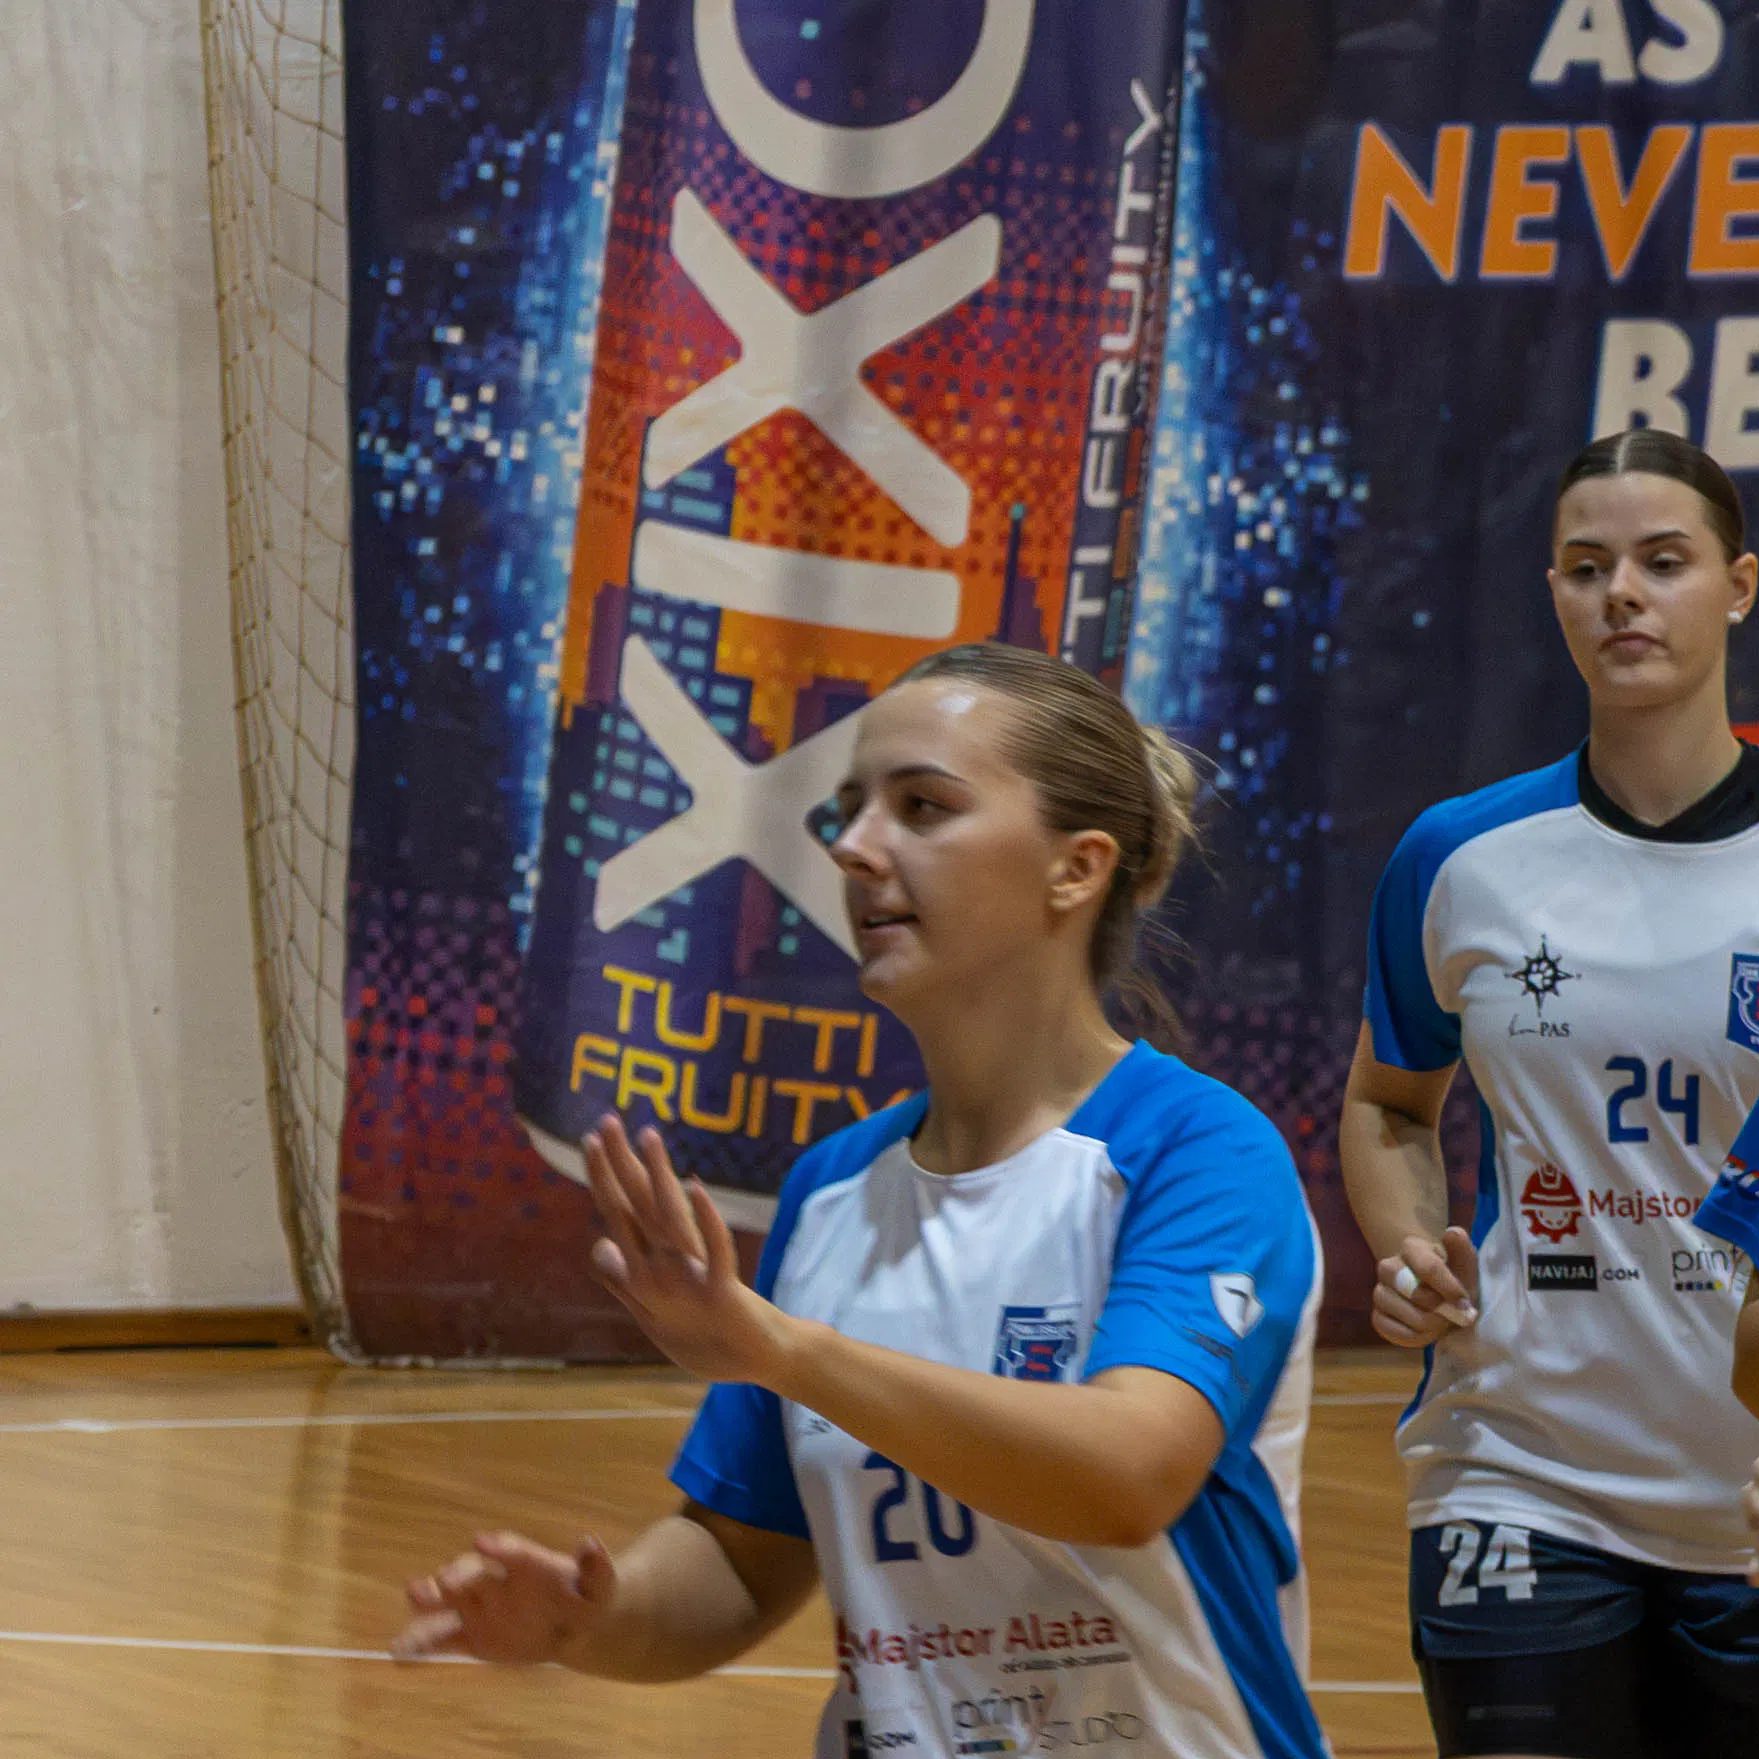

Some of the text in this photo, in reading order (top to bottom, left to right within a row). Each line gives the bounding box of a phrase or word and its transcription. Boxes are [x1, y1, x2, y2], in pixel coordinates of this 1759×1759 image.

[1084, 77, 1163, 509] FRUITY
[602, 964, 879, 1077] TUTTI
[569, 1033, 914, 1145] FRUITY
[1604, 1055, 1700, 1146] 24
[1438, 1524, 1538, 1608] 24
[1004, 1611, 1119, 1653] Alata
